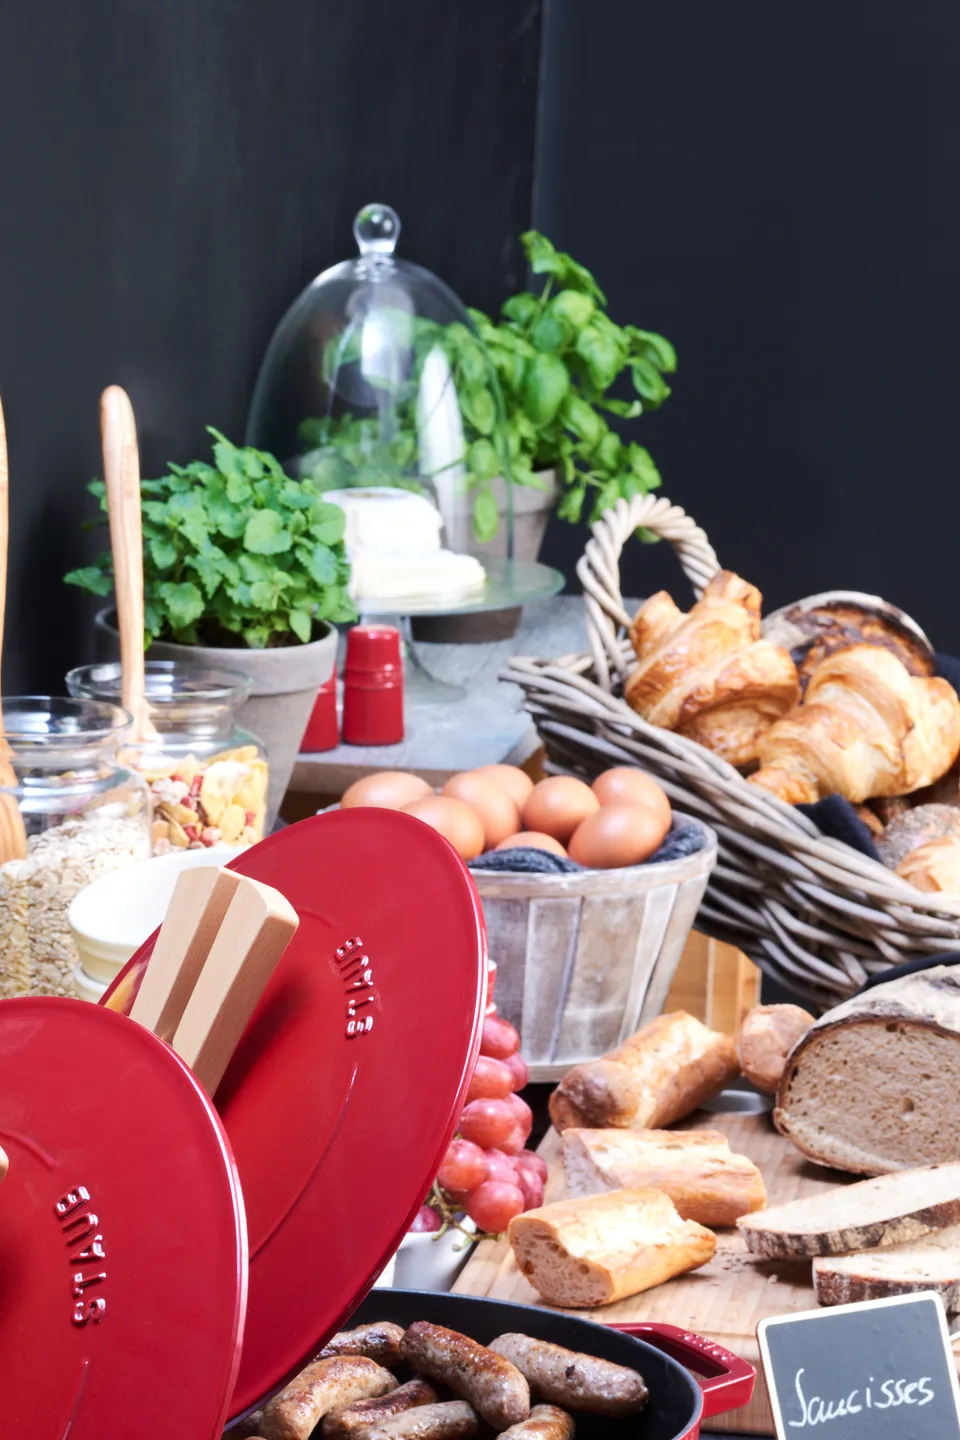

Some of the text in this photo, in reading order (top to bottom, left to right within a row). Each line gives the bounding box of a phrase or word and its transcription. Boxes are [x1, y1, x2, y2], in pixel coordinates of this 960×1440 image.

[335, 935, 376, 1040] STAUB
[53, 1184, 108, 1327] STAUB
[788, 1368, 935, 1427] Saucisses
